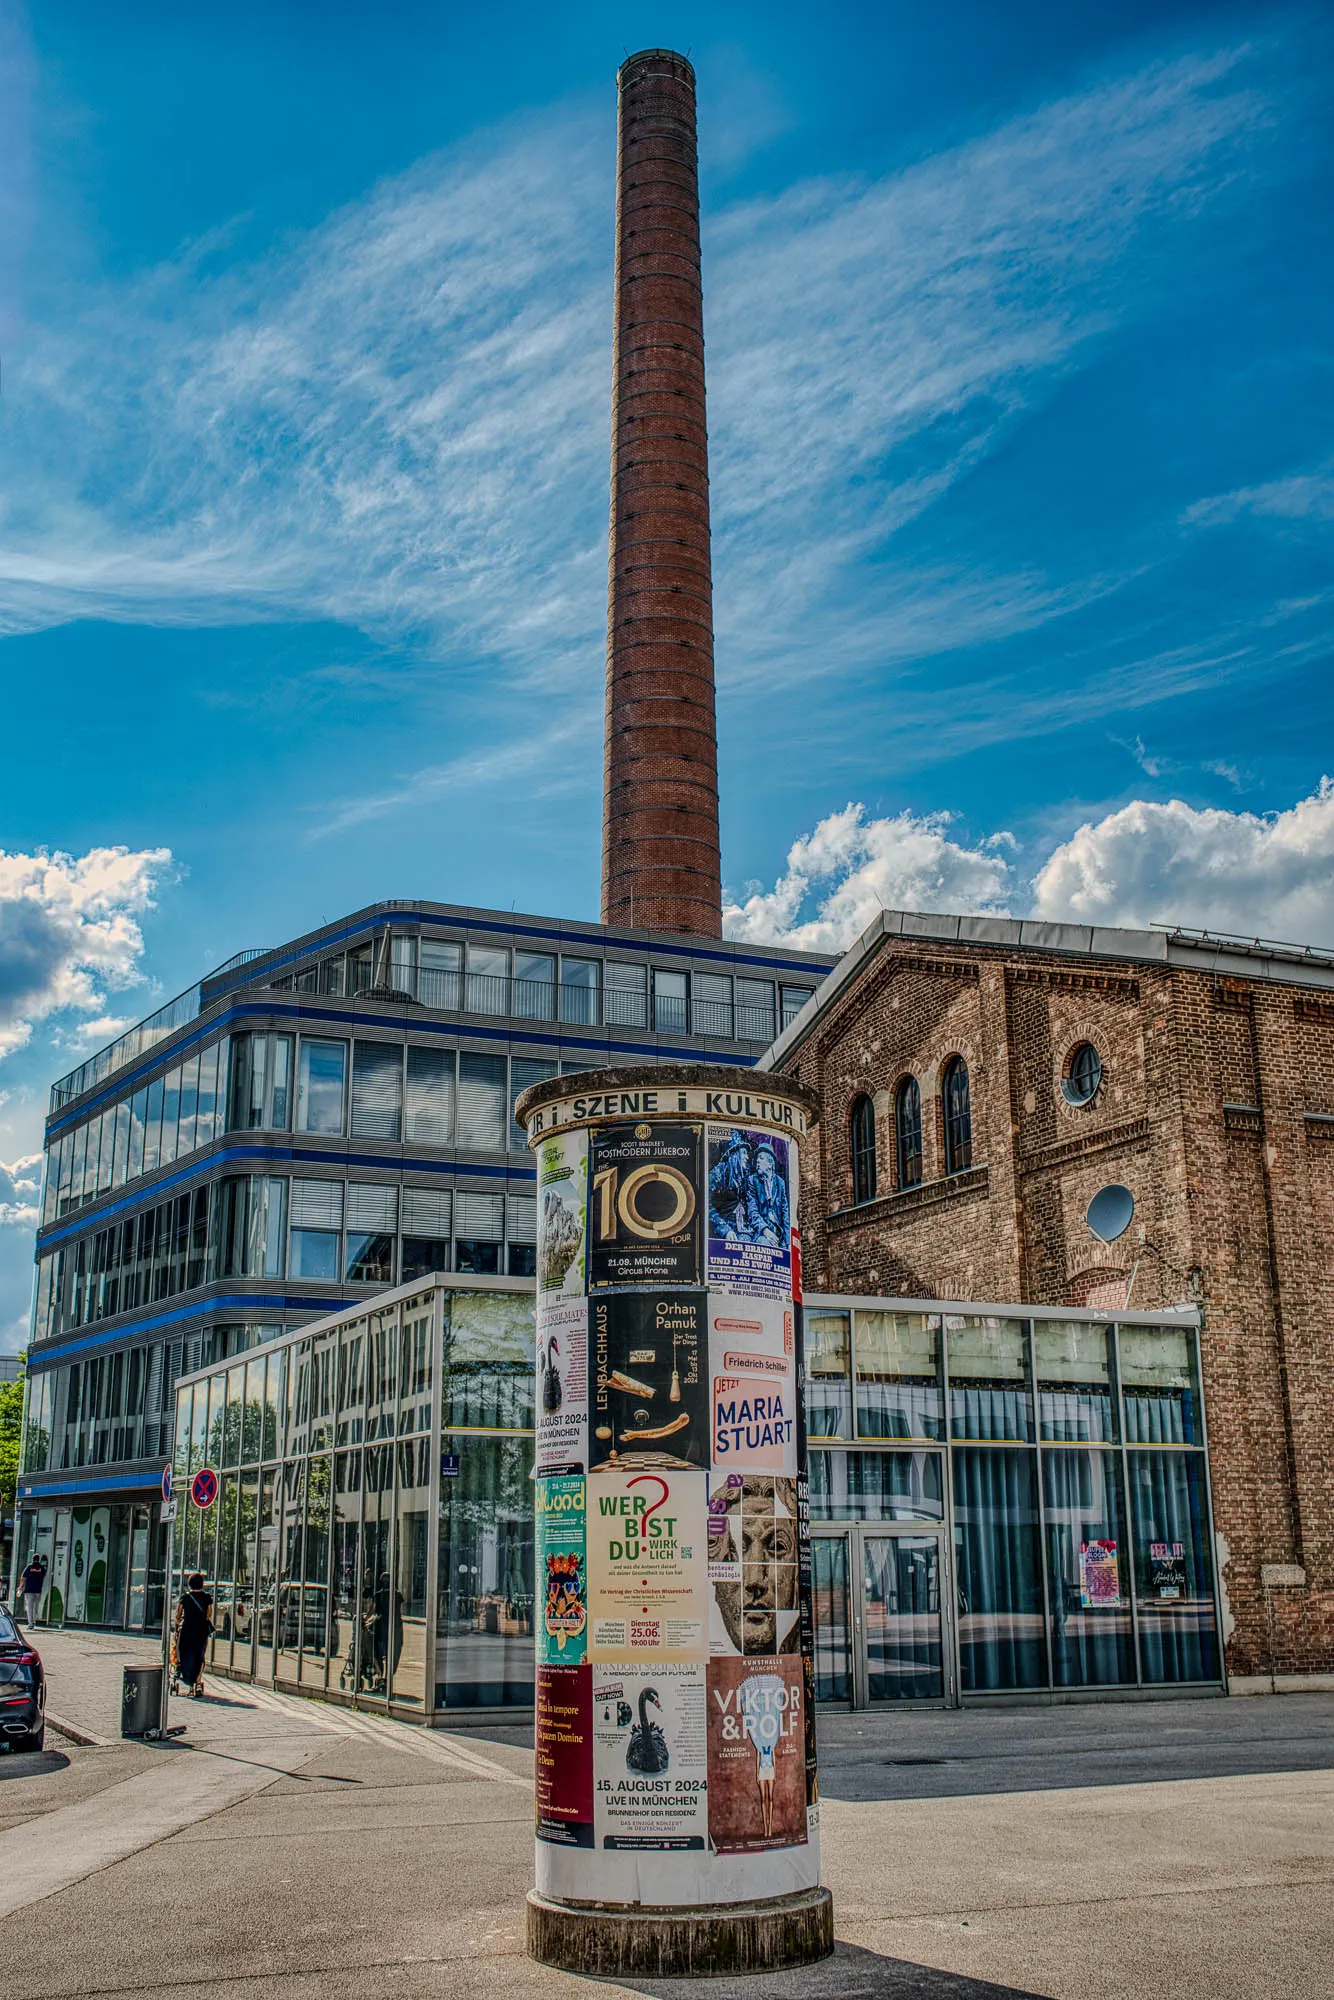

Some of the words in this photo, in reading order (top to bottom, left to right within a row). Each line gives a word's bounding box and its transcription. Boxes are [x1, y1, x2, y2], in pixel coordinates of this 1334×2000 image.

[552, 1106, 558, 1125] i
[573, 1092, 658, 1119] SZENE
[678, 1092, 686, 1112] i
[706, 1093, 792, 1126] KULTUR
[598, 1148, 651, 1158] POSTMODERN
[653, 1148, 690, 1156] JUKEBOX
[598, 1162, 609, 1172] THE
[593, 1164, 696, 1240] 10
[671, 1233, 691, 1244] TOUR
[724, 1242, 743, 1251] DER
[745, 1244, 784, 1258] BRANDNER
[608, 1258, 631, 1267] 21.09.
[634, 1256, 677, 1266] MÜNCHEN
[710, 1257, 730, 1265] UND
[732, 1258, 750, 1266] DAS
[742, 1252, 772, 1262] KASPAR
[618, 1267, 642, 1275] Circus
[644, 1267, 669, 1275] Krone
[656, 1302, 696, 1315] Orhan
[656, 1316, 696, 1329] Pamuk
[597, 1304, 608, 1410] LENBACHHAUS
[728, 1358, 764, 1368] Friedrich
[766, 1361, 787, 1372] Schiller
[717, 1379, 739, 1394] JETZT
[717, 1396, 783, 1427] MARIA
[540, 1416, 563, 1428] AUGUST
[565, 1413, 587, 1425] 2024
[548, 1428, 580, 1438] MÜNCHEN
[716, 1420, 792, 1453] STUART
[449, 1456, 453, 1467] 1
[599, 1496, 647, 1516] WER
[649, 1540, 678, 1549] WIRK
[610, 1541, 639, 1560] DU
[650, 1550, 674, 1560] LICH
[1151, 1544, 1169, 1557] FEEL
[631, 1620, 660, 1628] Dienstag
[631, 1628, 660, 1638] 25.06.
[714, 1686, 800, 1714] VIKTOR
[554, 1706, 579, 1717] tempore
[558, 1732, 583, 1743] Domine
[597, 1780, 614, 1791] 15.
[617, 1780, 671, 1791] AUGUST
[675, 1780, 708, 1791] 2024
[606, 1796, 626, 1805] LIVE
[629, 1796, 639, 1805] IN
[642, 1795, 697, 1805] MÜNCHEN
